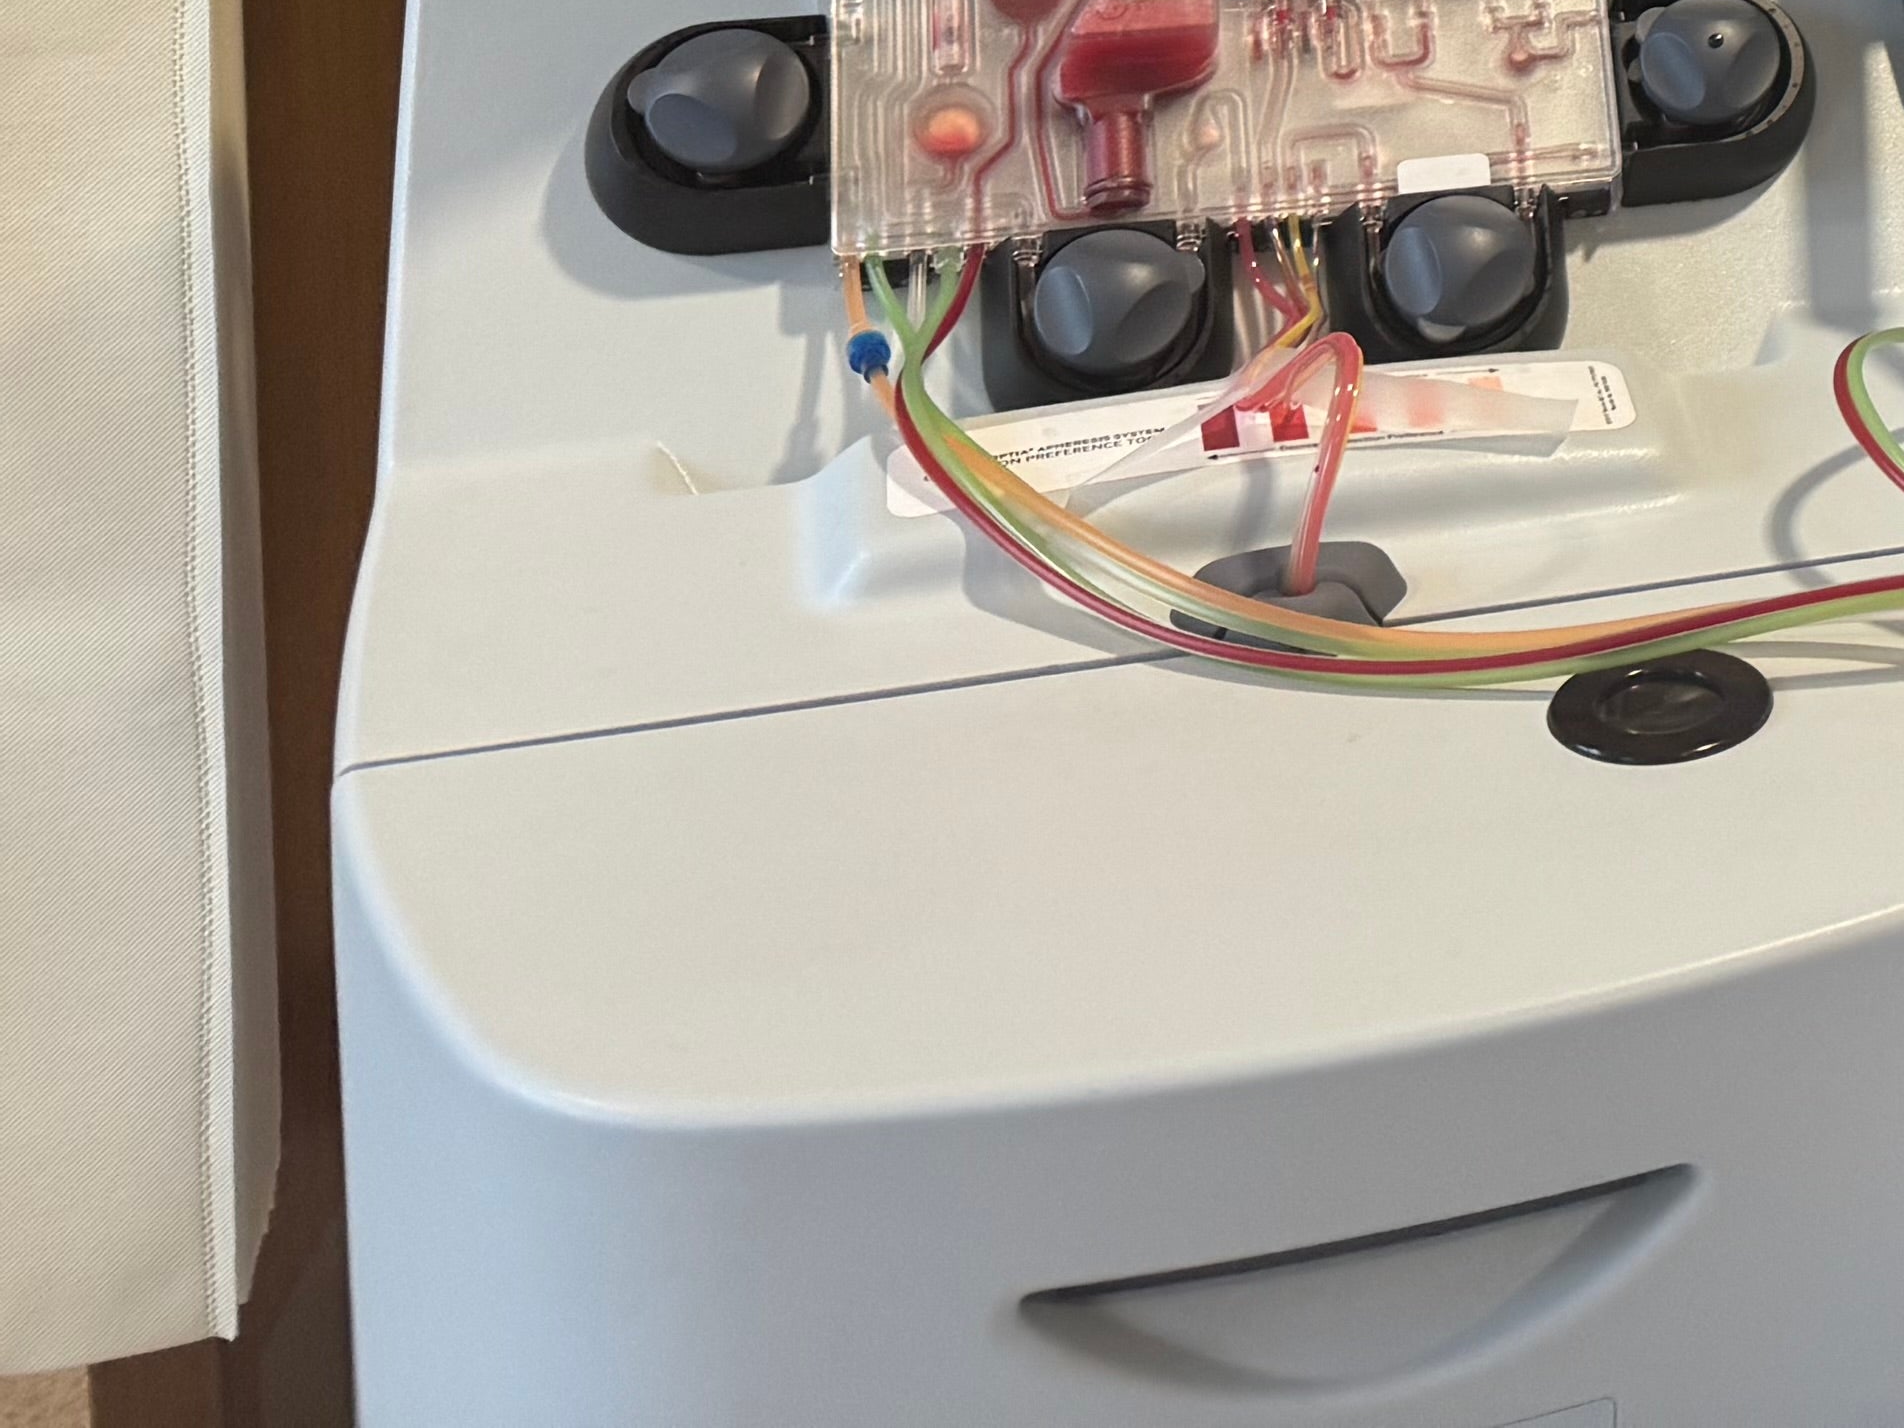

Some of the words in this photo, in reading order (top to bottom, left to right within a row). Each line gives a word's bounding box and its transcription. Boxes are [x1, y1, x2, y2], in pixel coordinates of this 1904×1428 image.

[1025, 440, 1122, 463] PREFERENCE
[1037, 436, 1112, 453] APHERESIS
[1115, 426, 1166, 443] SYSTEM
